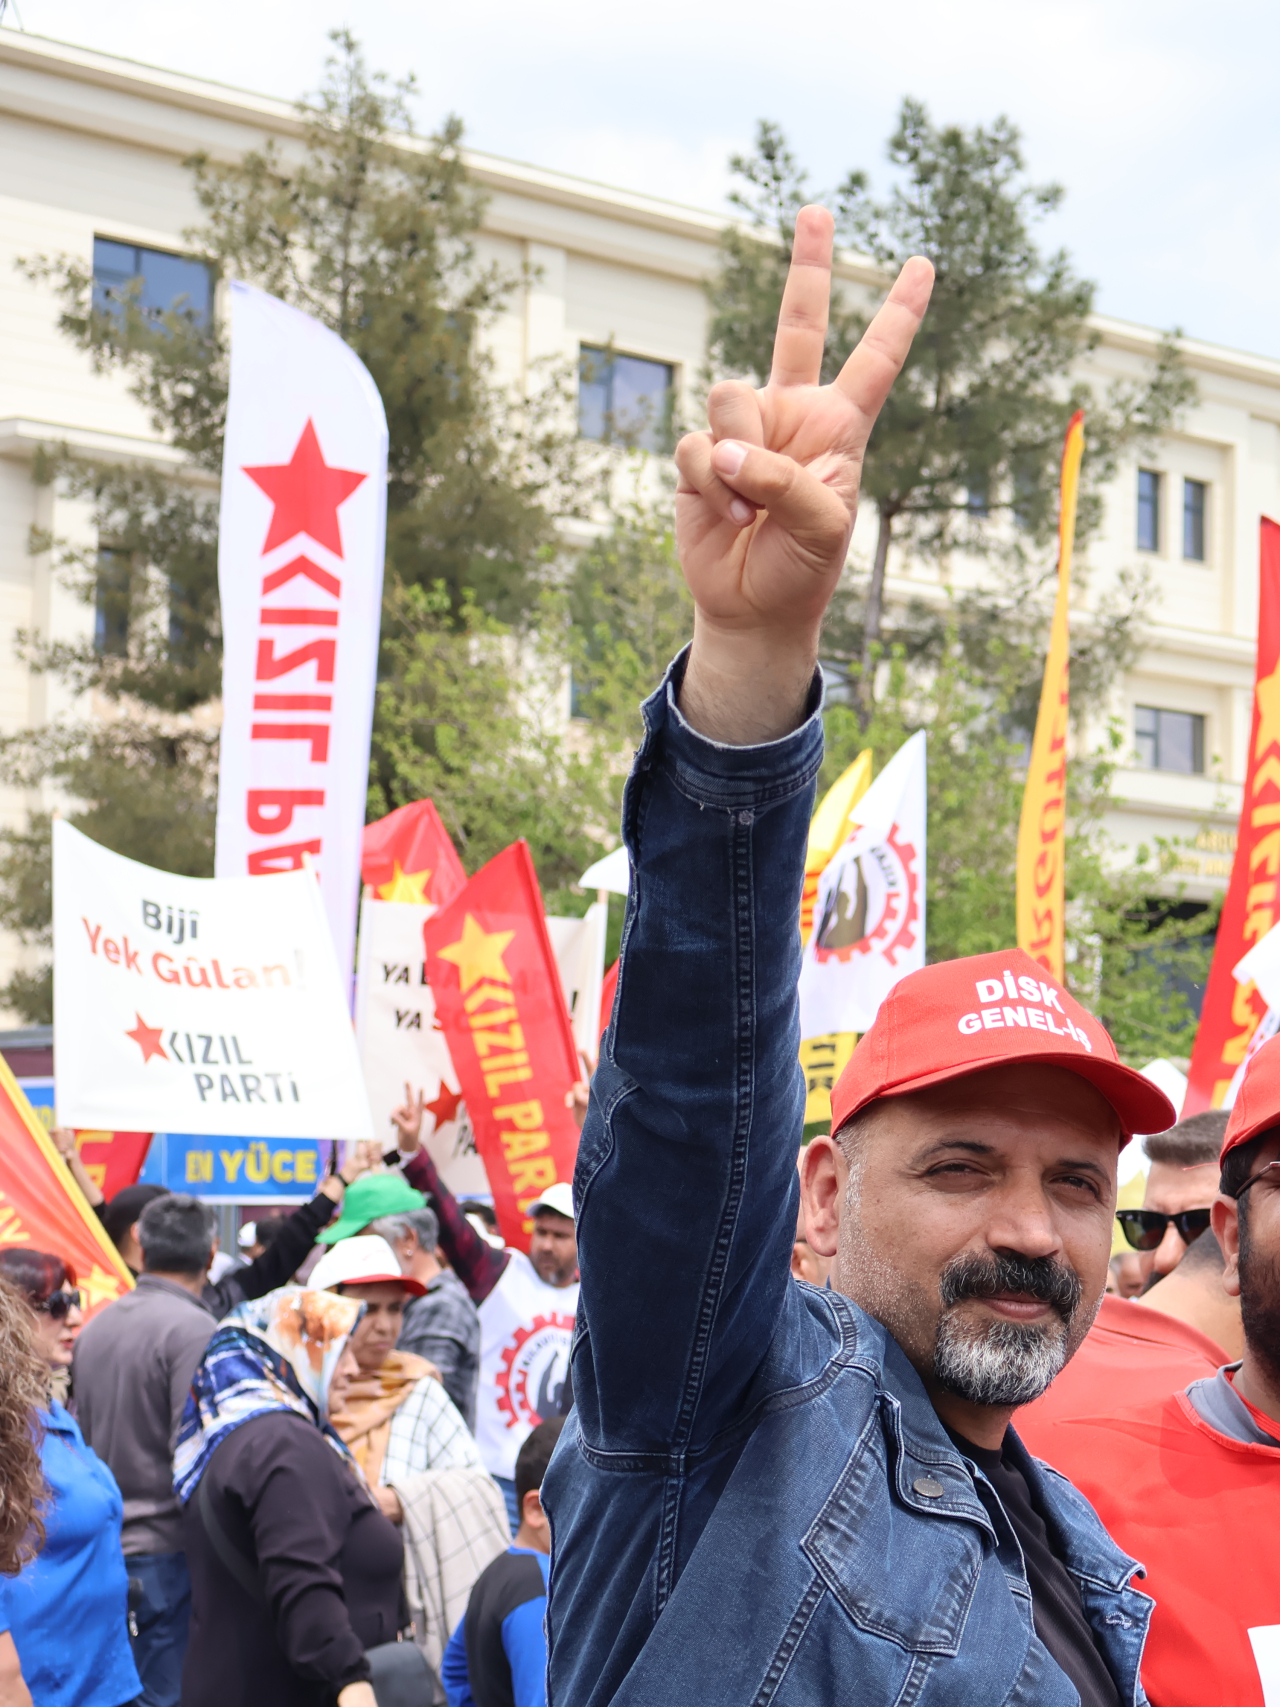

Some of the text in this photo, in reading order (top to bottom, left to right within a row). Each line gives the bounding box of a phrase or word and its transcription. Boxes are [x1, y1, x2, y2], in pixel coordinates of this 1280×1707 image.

[81, 915, 143, 976] Yek
[382, 962, 410, 986] YA
[975, 970, 1065, 1014] DİSK
[394, 1008, 421, 1031] YA
[218, 1141, 317, 1184] YÜCE
[493, 1099, 559, 1233] PAR
